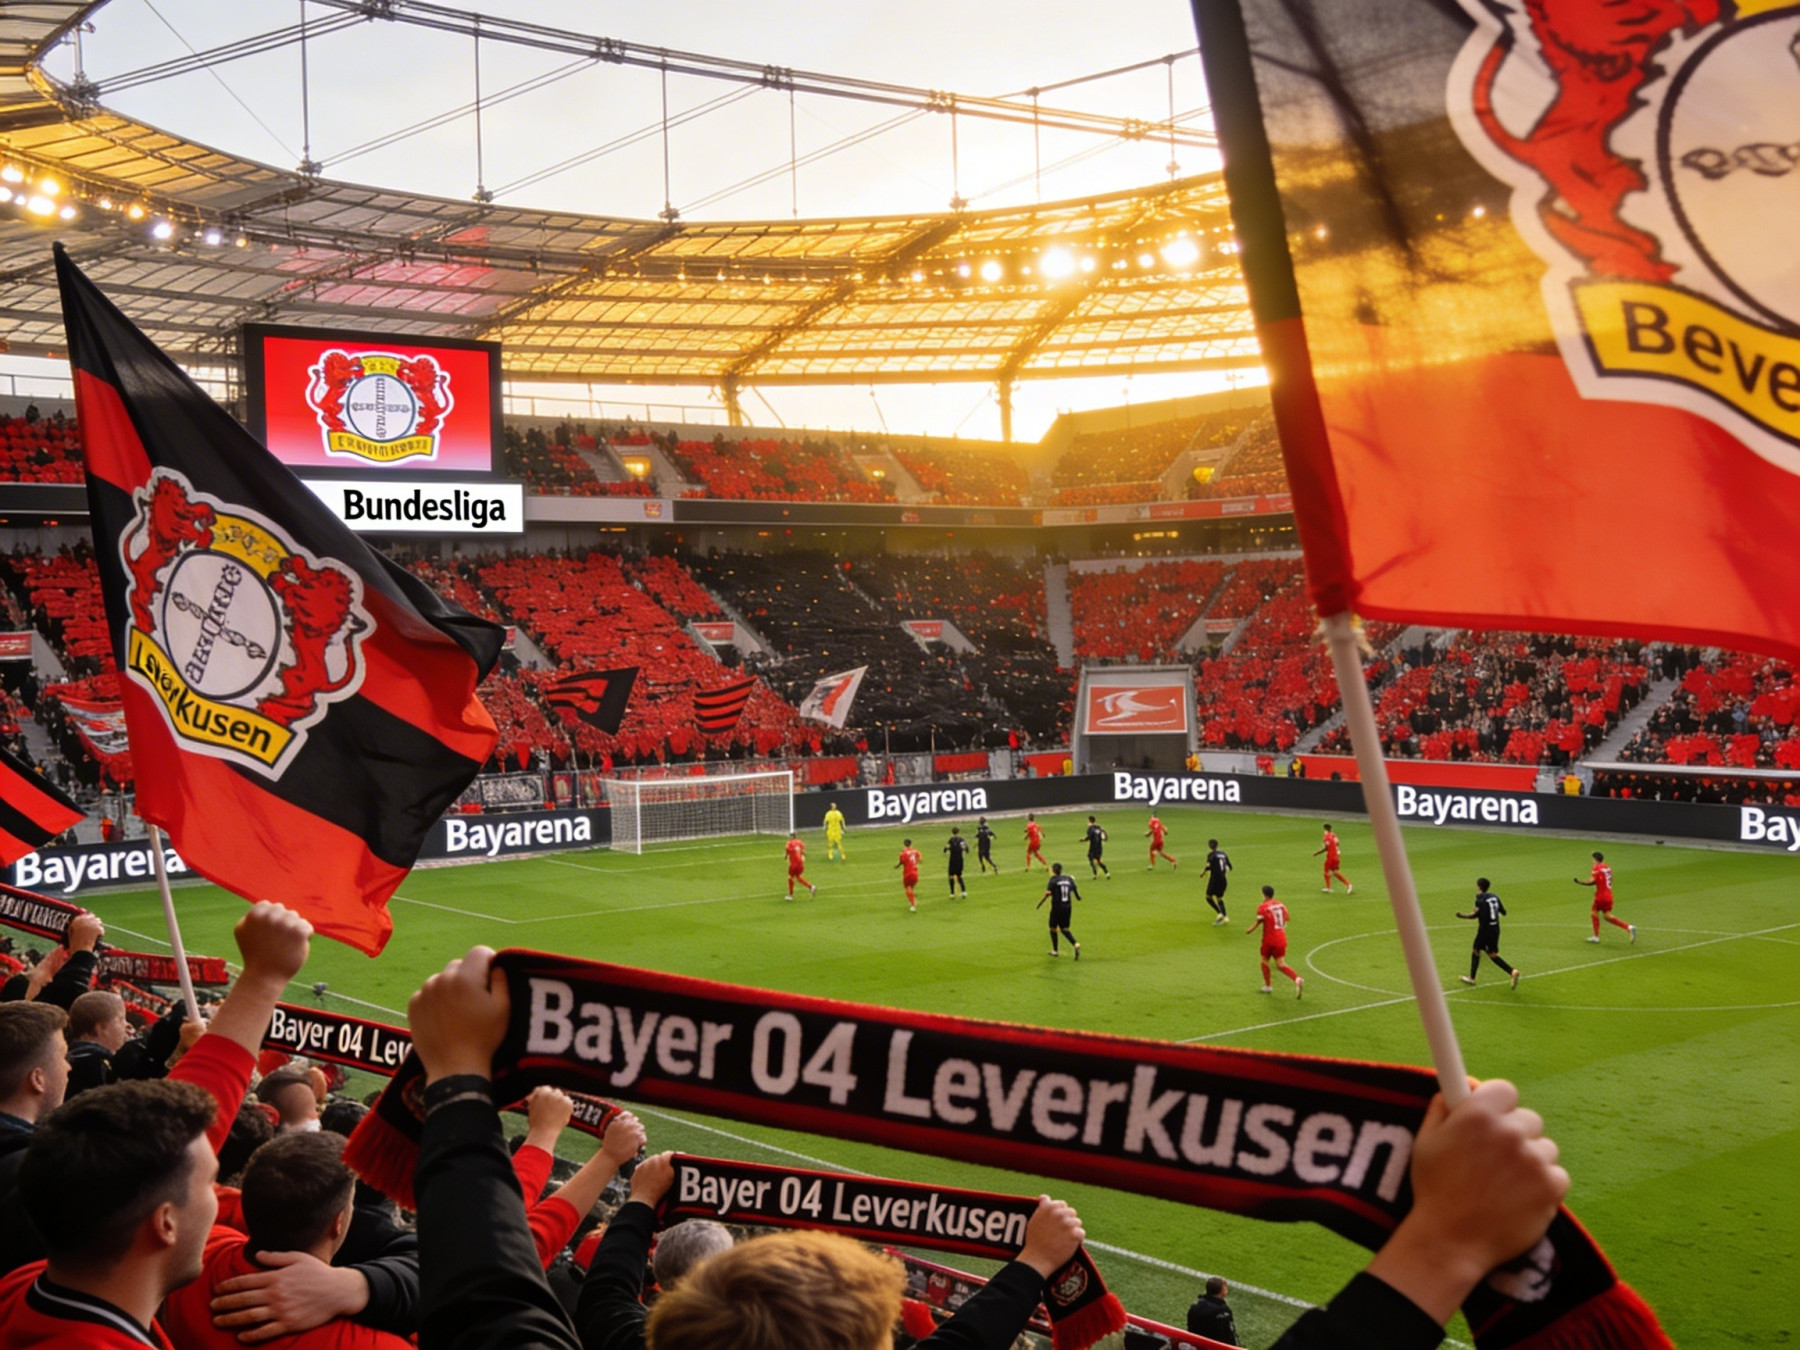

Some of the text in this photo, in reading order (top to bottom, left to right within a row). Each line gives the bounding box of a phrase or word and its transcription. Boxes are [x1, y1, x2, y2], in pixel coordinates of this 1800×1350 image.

[344, 489, 506, 529] Bundesliga
[867, 788, 988, 824] Bayarena
[1114, 772, 1241, 807] Bayarena
[1397, 786, 1539, 826] Bayarena
[444, 815, 592, 857] Bayarena
[270, 1008, 335, 1052] Bayer
[338, 1023, 363, 1058] 04
[528, 982, 1413, 1201] Bayer 04 Leverkusen
[680, 1166, 1026, 1246] Bayer 04 Leverkusen
